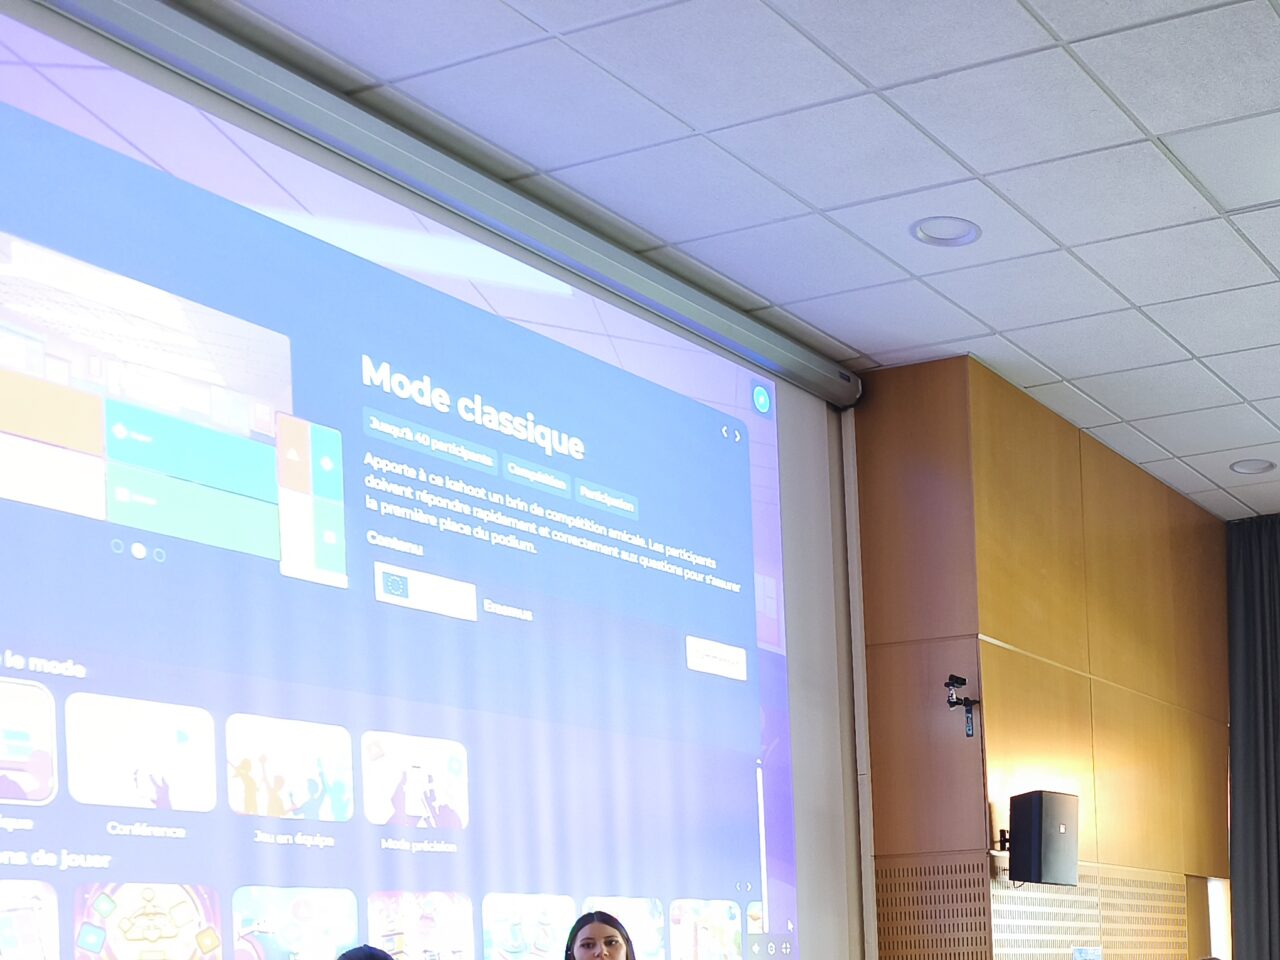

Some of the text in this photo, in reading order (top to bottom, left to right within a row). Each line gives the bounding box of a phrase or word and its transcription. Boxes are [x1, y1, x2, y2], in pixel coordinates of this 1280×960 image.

[362, 354, 585, 460] Mode classique
[364, 451, 417, 479] Apporte
[418, 467, 427, 482] à
[428, 473, 444, 487] ce
[445, 475, 487, 500] kahoot
[488, 490, 504, 505] un
[505, 494, 529, 512] brin
[529, 502, 544, 517] de
[545, 508, 607, 536] compétition
[648, 538, 664, 553] Les
[665, 545, 717, 569] participants
[364, 474, 414, 499] doivent
[415, 489, 471, 515] répondre
[472, 506, 538, 535] rapidement
[538, 525, 551, 538] et
[551, 529, 620, 558] correctement
[620, 549, 639, 564] aux
[639, 555, 683, 577] questions
[684, 568, 705, 583] pour
[365, 494, 378, 511] la
[380, 501, 438, 526] première
[438, 517, 472, 536] place
[472, 525, 490, 541] du
[4, 649, 87, 678] le mode
[106, 820, 187, 838] Conférence
[275, 832, 293, 845] en
[31, 849, 58, 866] de
[59, 848, 112, 870] jouer
